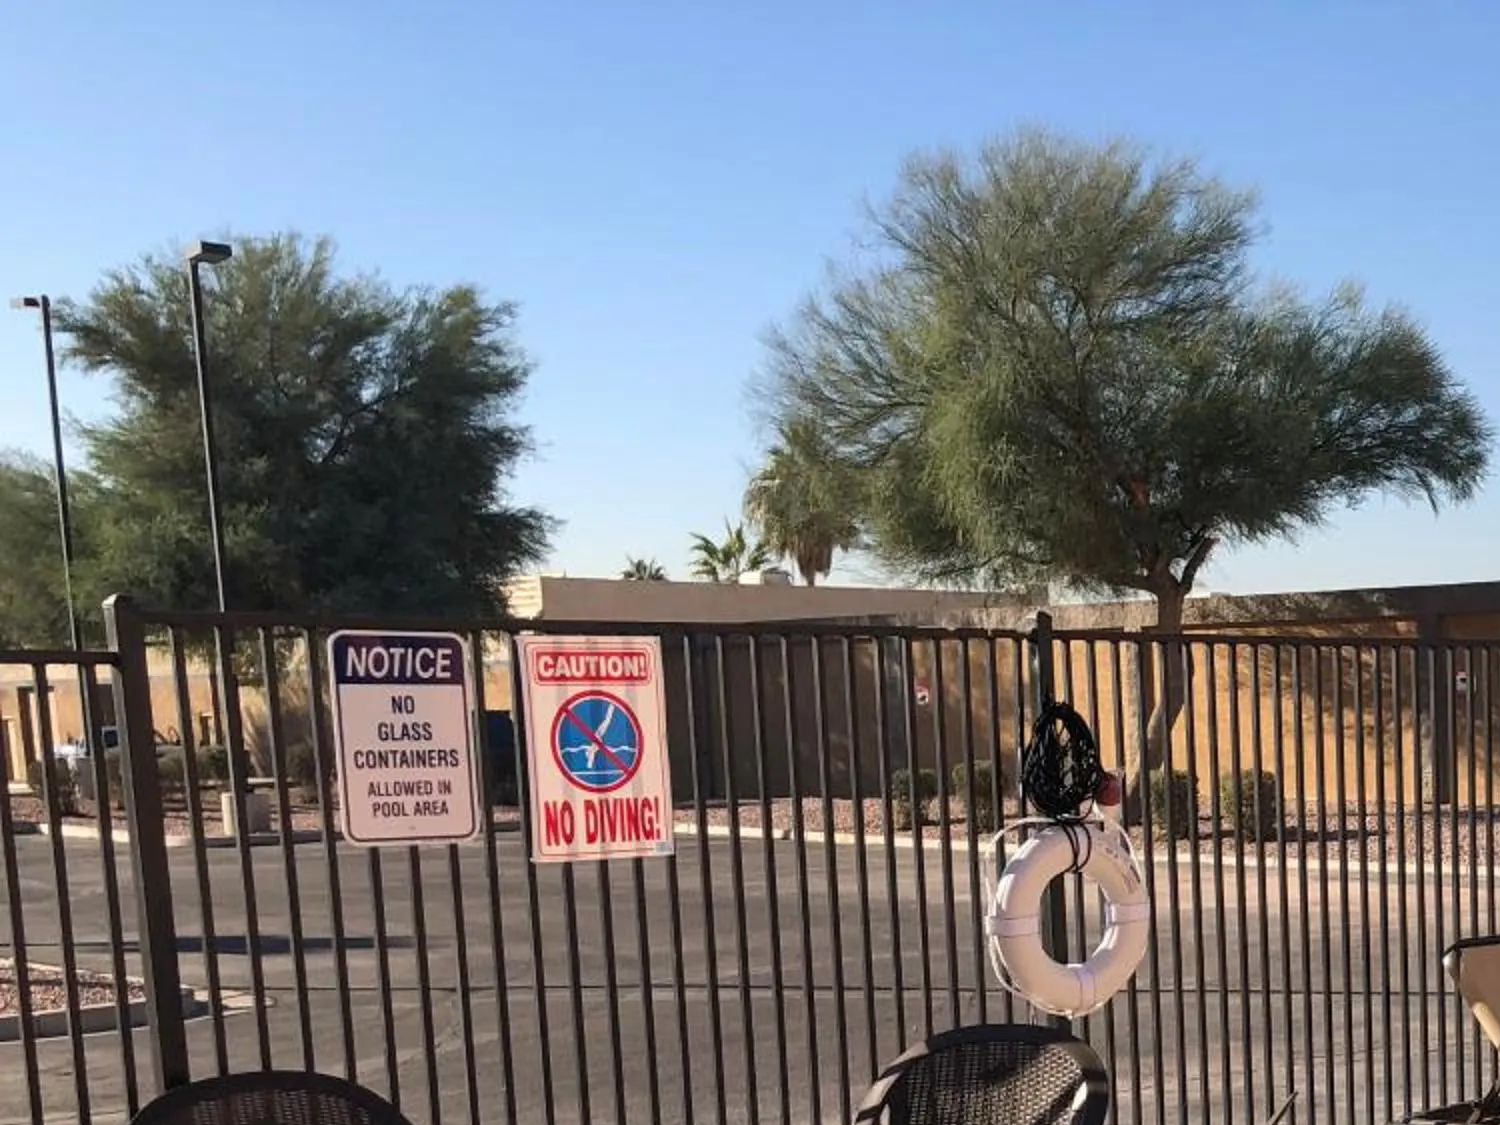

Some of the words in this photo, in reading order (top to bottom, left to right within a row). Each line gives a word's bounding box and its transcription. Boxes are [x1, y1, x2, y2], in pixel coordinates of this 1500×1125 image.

[346, 647, 452, 679] NOTICE
[537, 654, 647, 678] CAUTION!
[391, 695, 415, 714] NO
[377, 723, 433, 741] GLASS
[354, 749, 459, 769] CONTAINERS
[367, 781, 433, 797] ALLOWED
[438, 780, 451, 795] IN
[372, 802, 409, 817] POOL
[413, 800, 449, 816] AREA
[543, 801, 574, 846] NO
[585, 797, 661, 844] DIVING!
